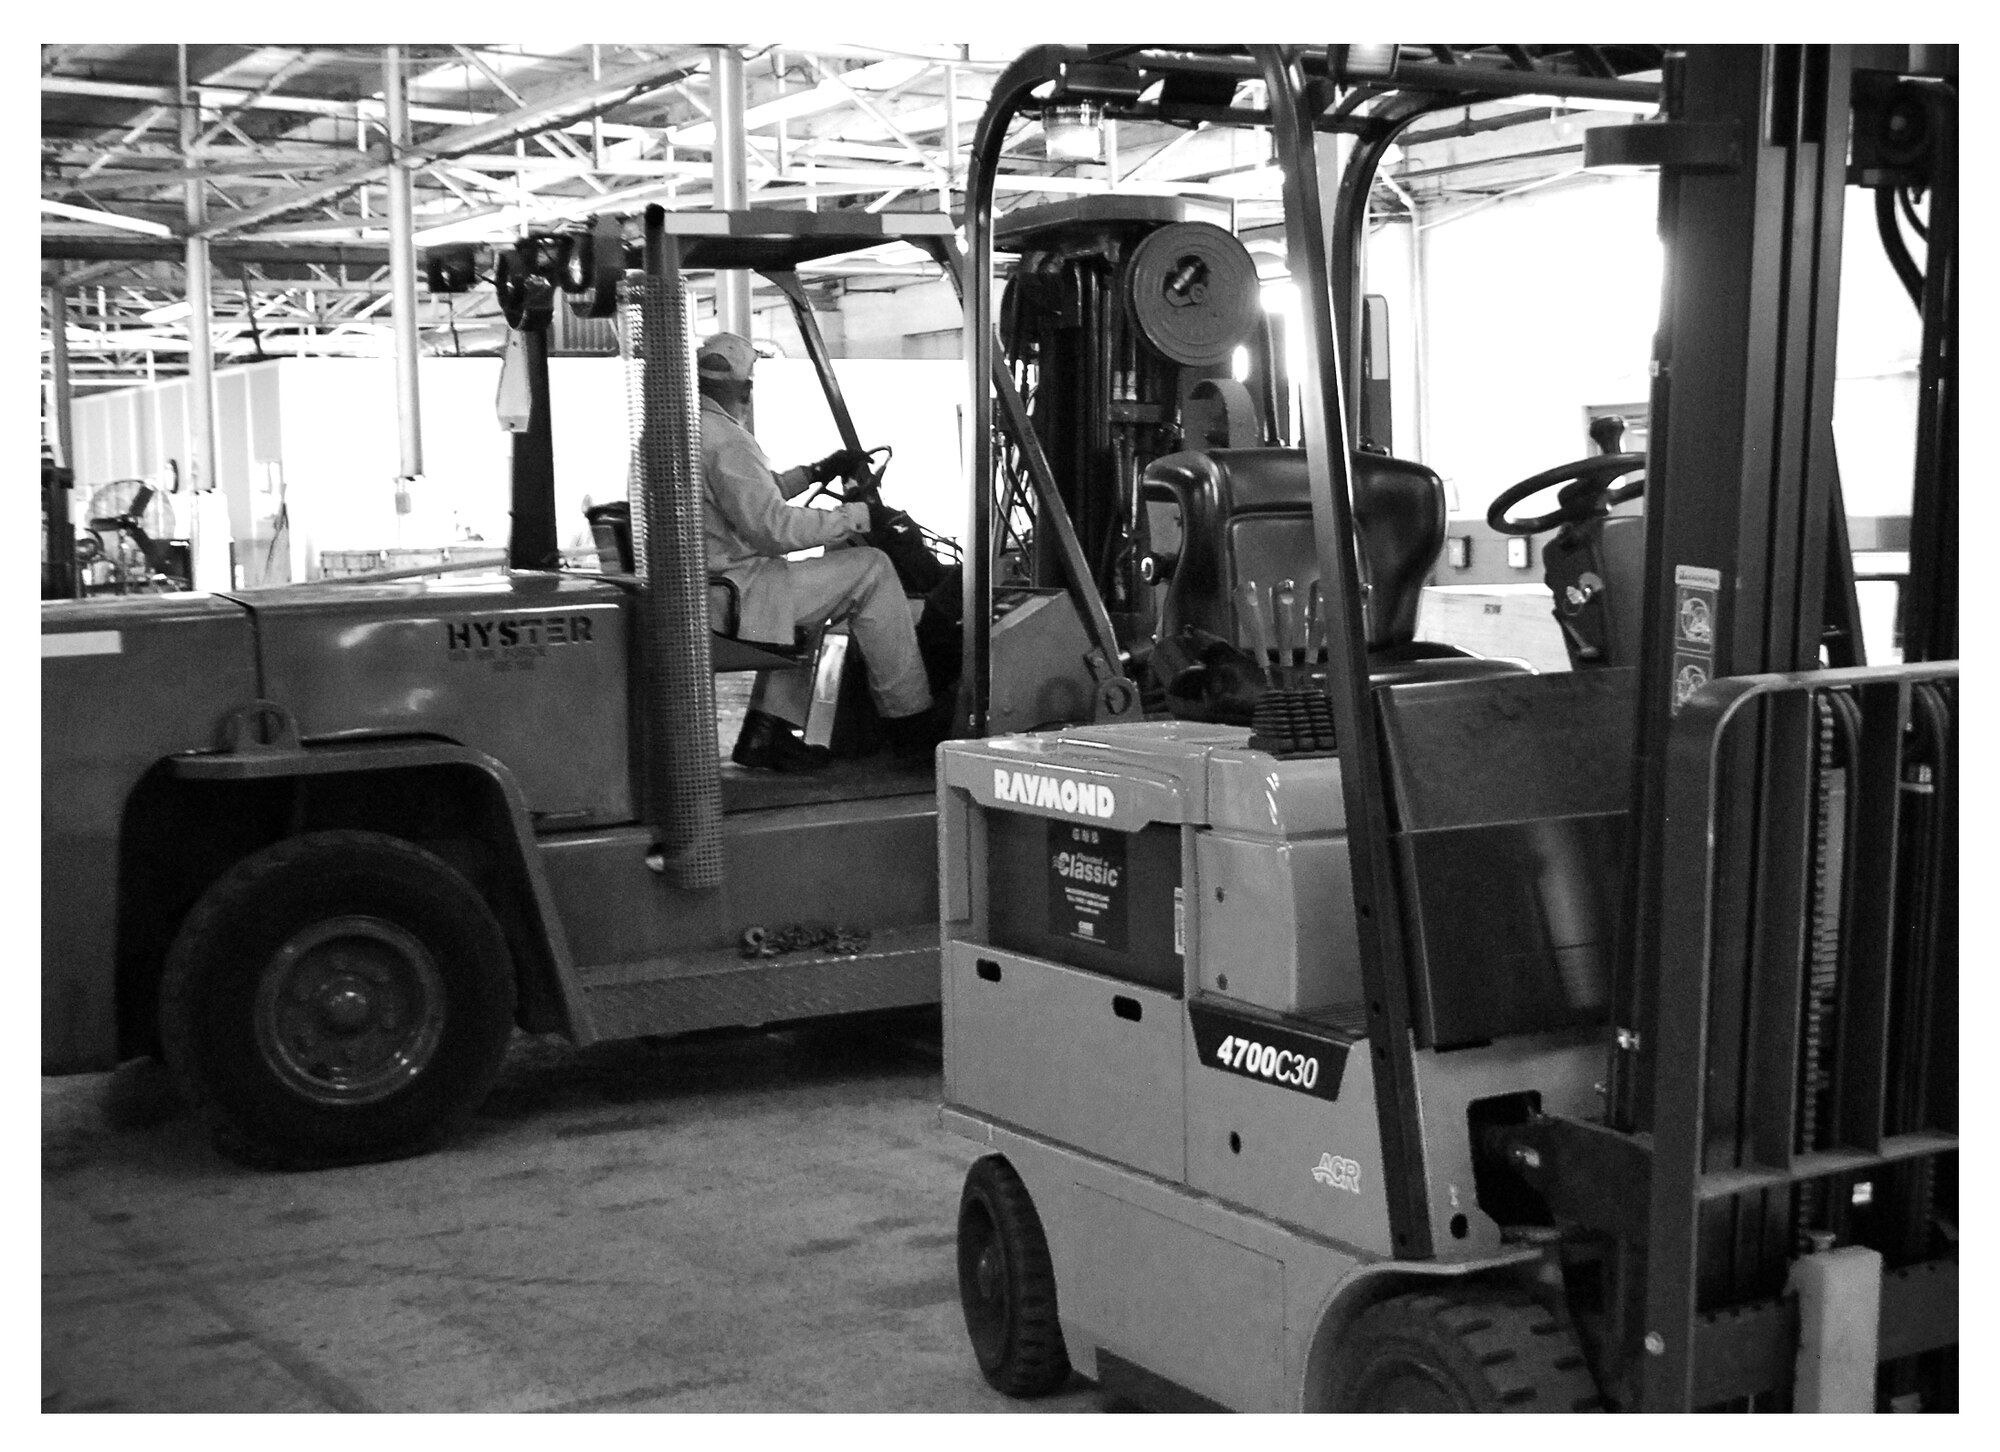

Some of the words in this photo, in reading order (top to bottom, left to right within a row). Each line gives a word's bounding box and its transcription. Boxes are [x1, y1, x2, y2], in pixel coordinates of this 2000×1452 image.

[446, 615, 593, 649] HYSTER
[993, 768, 1116, 819] RAYMOND
[1058, 851, 1119, 887] Classic
[1216, 1034, 1319, 1089] 4700C30
[1311, 1152, 1361, 1195] ACR
